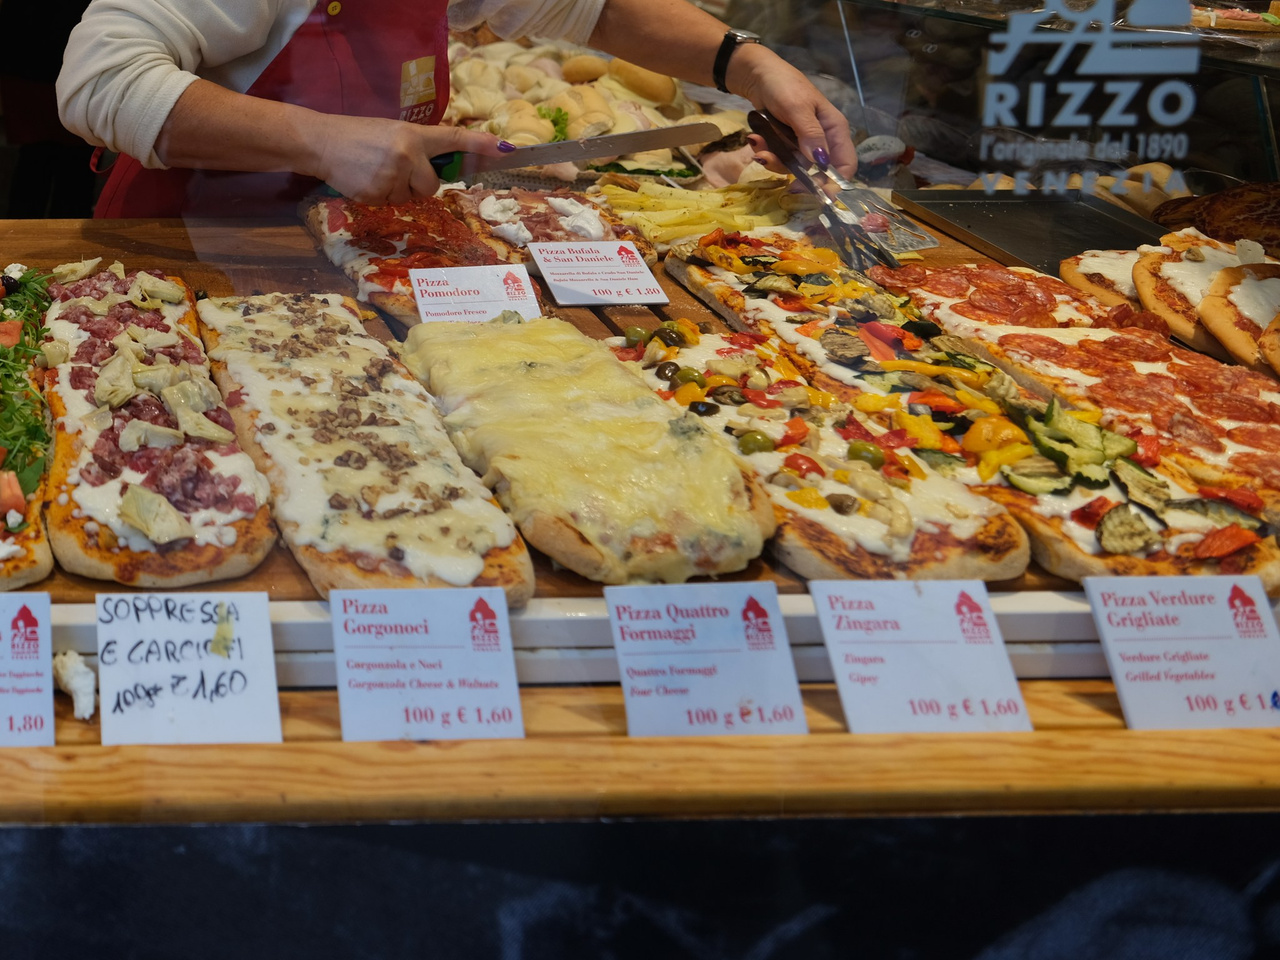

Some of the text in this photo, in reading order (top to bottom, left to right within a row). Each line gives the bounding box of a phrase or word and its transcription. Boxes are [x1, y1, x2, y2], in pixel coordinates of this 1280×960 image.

[400, 104, 434, 121] RIZZO
[982, 80, 1197, 127] RIZZO
[1094, 133, 1130, 160] dal
[1137, 132, 1189, 160] 1890
[979, 169, 1188, 194] VENEZIA
[416, 278, 449, 287] Pizza
[420, 288, 480, 298] Pomodoro
[342, 599, 388, 615] Pizza
[828, 595, 875, 610] Pizza
[1101, 590, 1216, 607] Pizza Verdure
[99, 596, 240, 624] SOPPRESSA
[615, 603, 729, 623] Pizza Quattro
[344, 619, 429, 639] Gorgonoci
[833, 615, 901, 634] Zingara
[1107, 611, 1180, 631] Grigliate
[620, 624, 696, 644] Formaggi
[100, 641, 117, 665] E
[844, 653, 885, 665] Zingara
[1119, 652, 1209, 663] Verdure Grigliate
[346, 659, 406, 670] Gorgonzola
[419, 660, 442, 669] Noci
[626, 665, 717, 679] Quattro Formaggi
[348, 679, 499, 690] Gorgonzola Cheese & Walnuts
[849, 673, 878, 685] Gipsy
[1125, 670, 1215, 683] Grilled Vegetables
[192, 670, 247, 703] 1,60
[630, 686, 689, 697] Four Cheese
[908, 698, 1019, 720] 100 g € 1,60
[1186, 694, 1251, 716] 100 g €
[7, 715, 44, 733] 1,80
[404, 707, 512, 728] 100 g € 1,60
[686, 709, 717, 725] 100
[724, 712, 734, 729] g
[757, 705, 794, 723] 1,60
